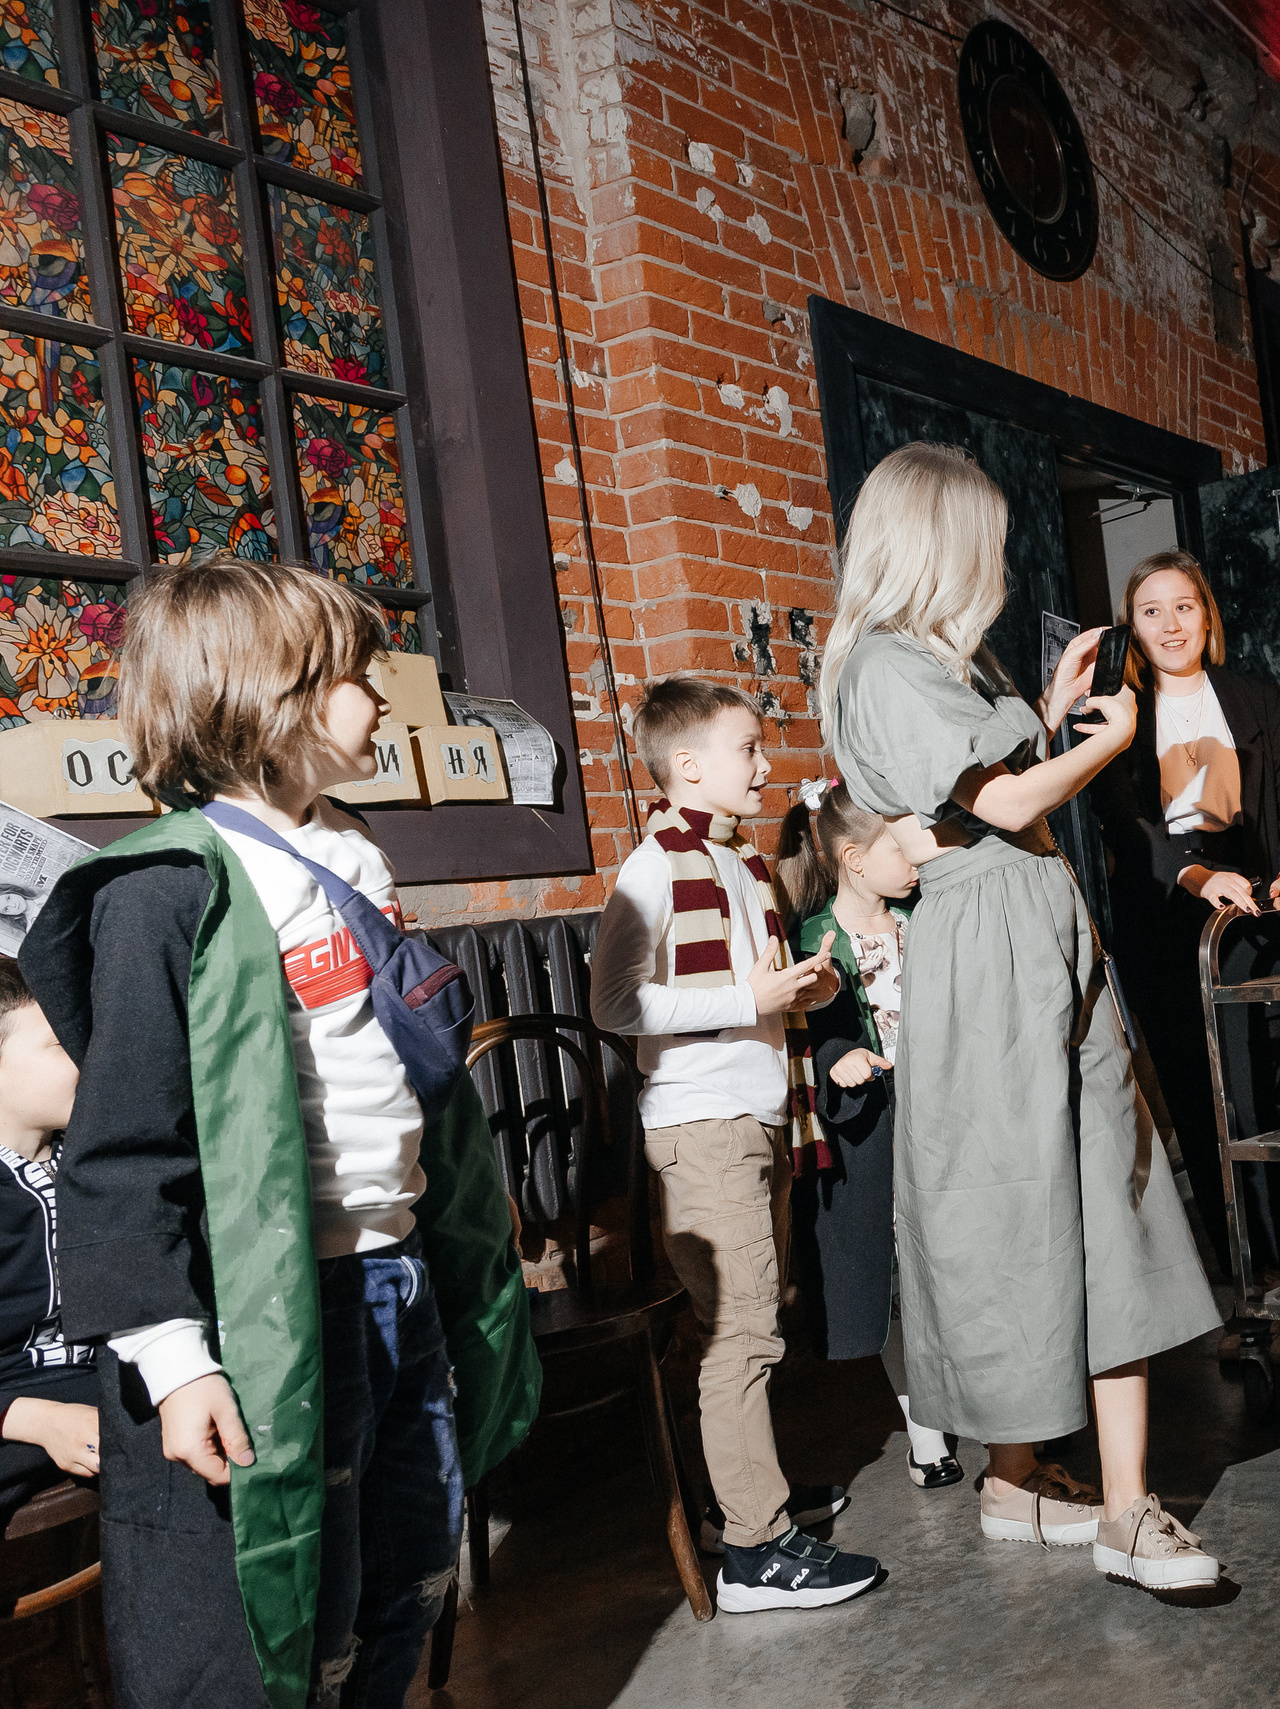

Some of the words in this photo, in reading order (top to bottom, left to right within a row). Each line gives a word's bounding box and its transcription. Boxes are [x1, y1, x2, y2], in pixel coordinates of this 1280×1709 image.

[986, 32, 998, 67] 11
[969, 56, 986, 91] 10
[981, 155, 996, 189] 8
[1033, 234, 1048, 262] 6
[1, 821, 20, 842] FOR
[760, 1562, 781, 1583] FILA
[790, 1568, 810, 1590] FILA
